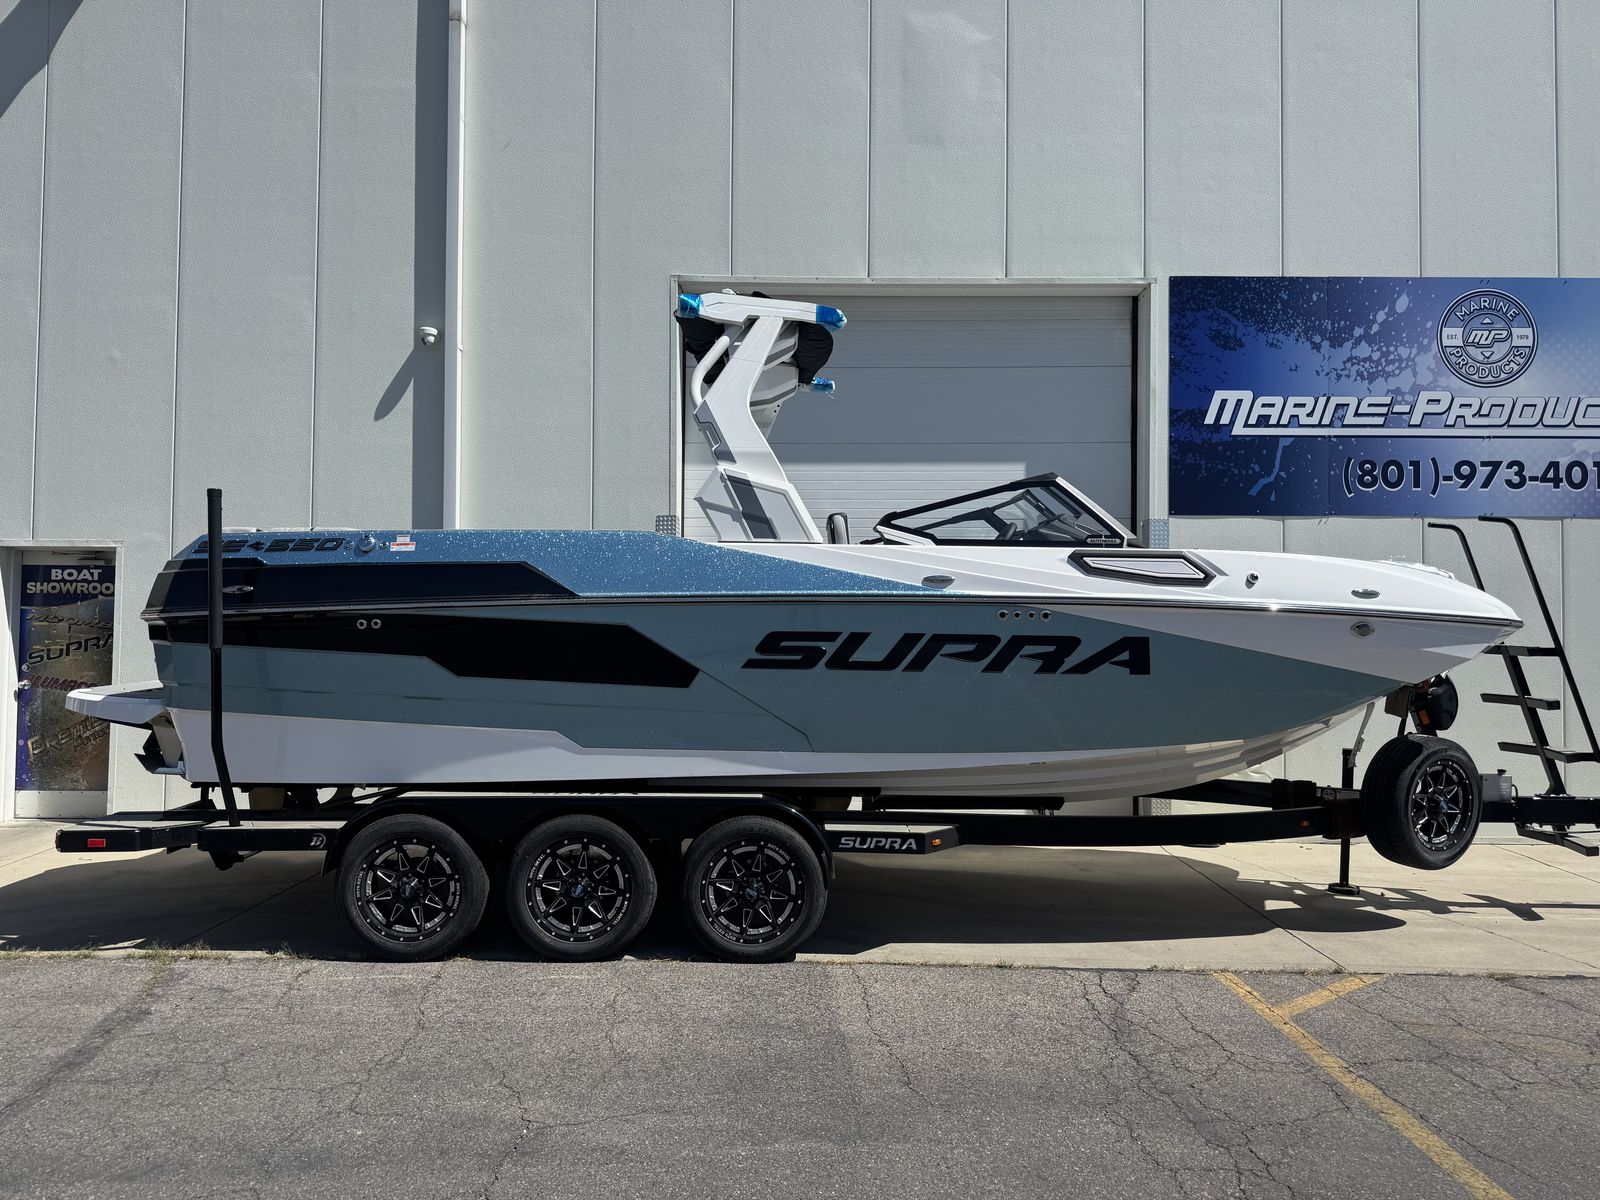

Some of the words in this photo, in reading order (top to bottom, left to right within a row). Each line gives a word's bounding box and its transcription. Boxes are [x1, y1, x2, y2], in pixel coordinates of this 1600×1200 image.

[1454, 297, 1520, 321] MARINE
[1449, 347, 1526, 378] PRODUCTS
[263, 537, 346, 552] 550
[51, 568, 102, 581] BOAT
[740, 630, 1151, 675] SUPRA
[838, 836, 918, 850] SUPRA
